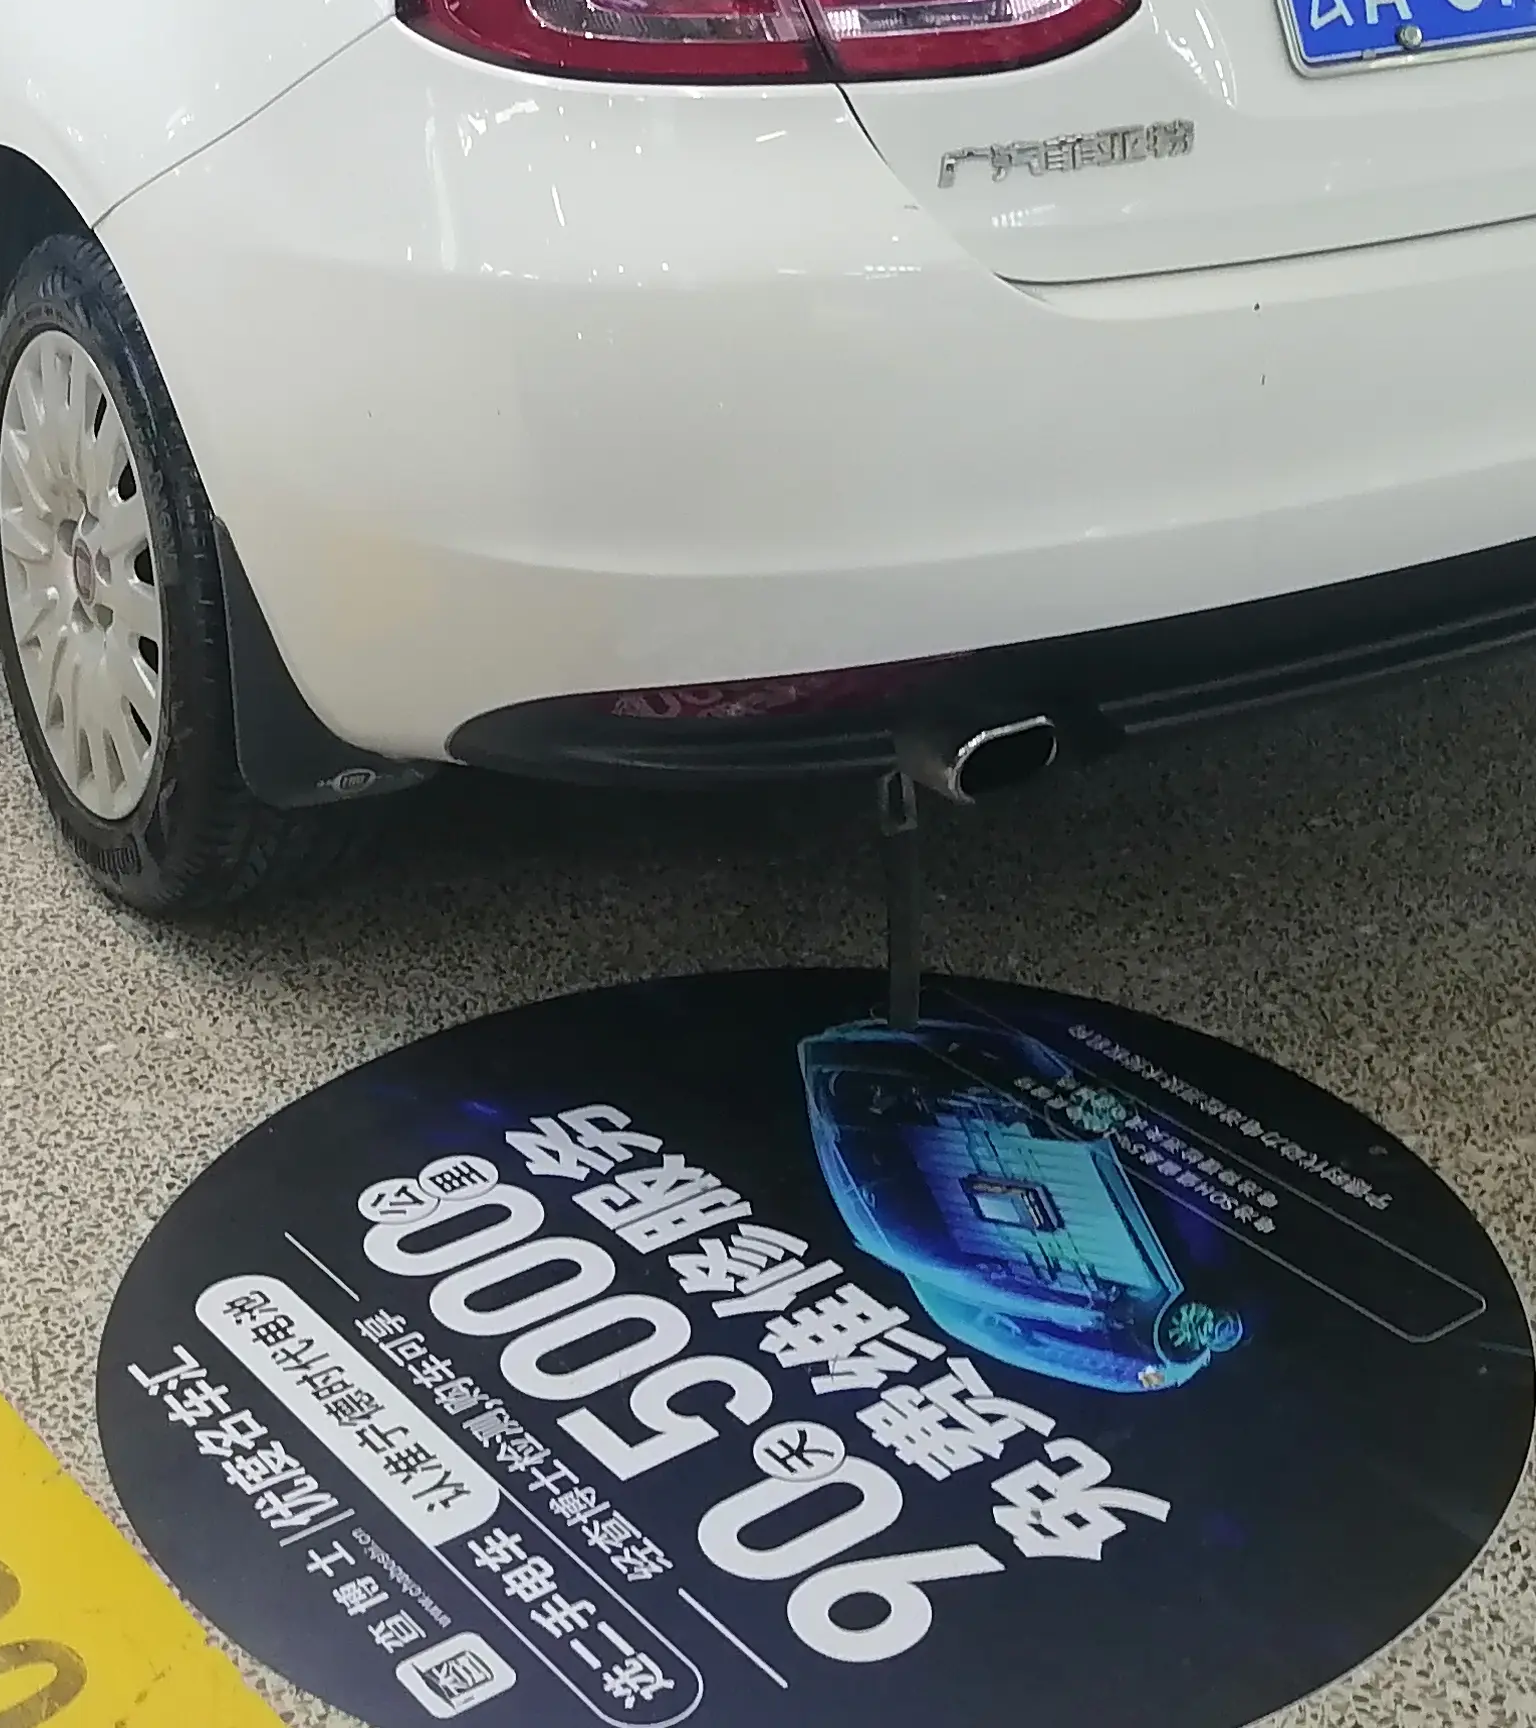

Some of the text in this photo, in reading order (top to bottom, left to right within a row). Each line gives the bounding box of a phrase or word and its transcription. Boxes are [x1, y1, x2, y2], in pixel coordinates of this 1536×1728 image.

[938, 118, 1196, 189] 广汽菲亚特
[504, 1102, 1170, 1561] 免费维修服务
[126, 1343, 339, 1530] 优度名车汇
[222, 1288, 675, 1710] 选二手电车 认准宁德时代电池
[306, 1540, 428, 1655] 查博士
